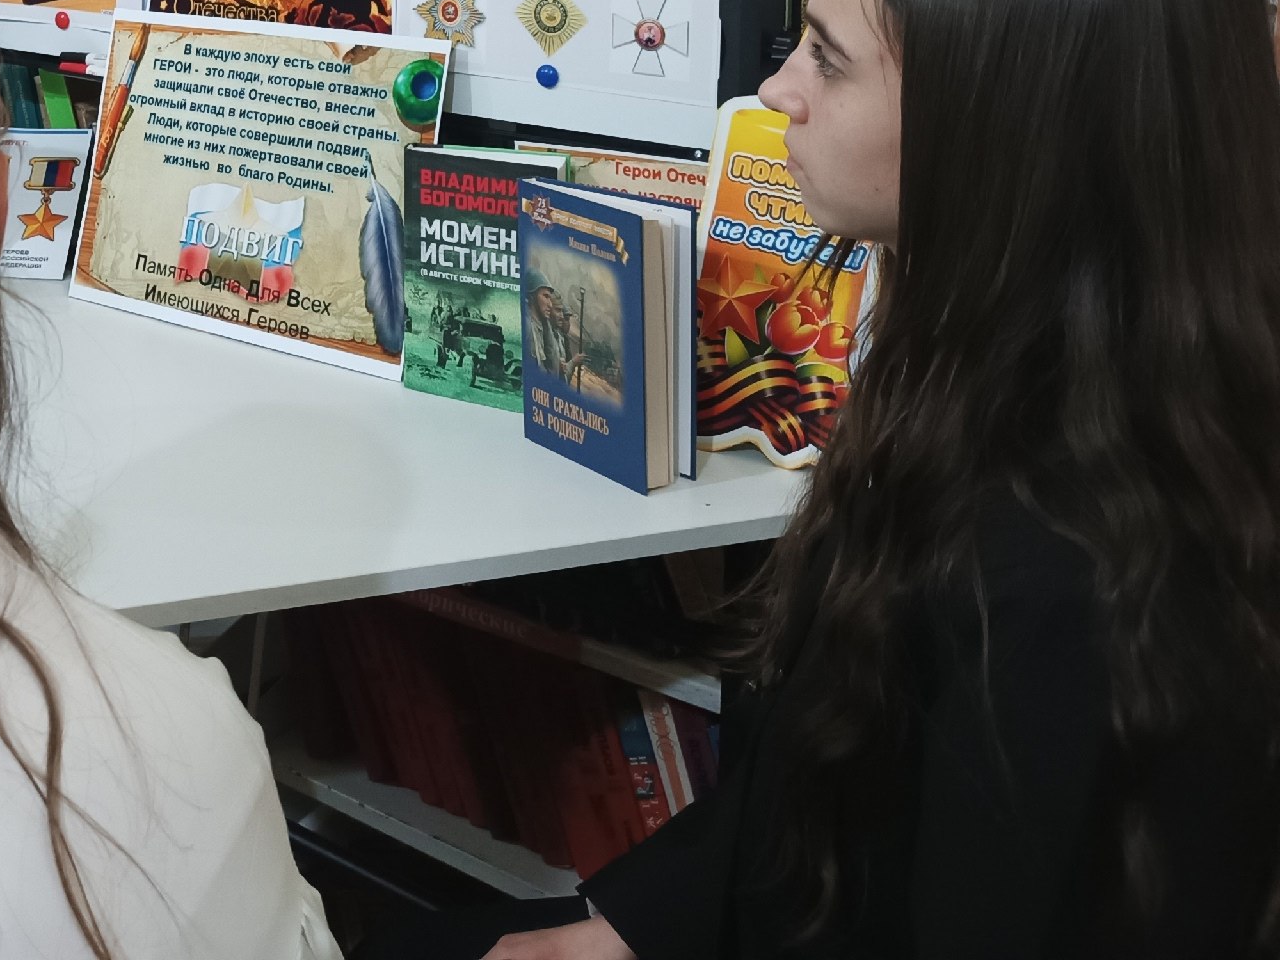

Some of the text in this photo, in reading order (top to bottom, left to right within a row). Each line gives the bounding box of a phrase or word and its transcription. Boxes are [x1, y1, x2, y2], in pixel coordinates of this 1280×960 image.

[183, 43, 352, 74] В каждую эпоху есть свои
[153, 59, 388, 100] ГЕРОИ это люди, которые отважно
[153, 78, 376, 118] защищали своё Отечество, внесли
[130, 93, 400, 142] огромный вклад в историю своей страны.
[143, 132, 368, 178] многие из них пожертвовали своей
[147, 113, 370, 162] Люди, которые совершили подвиг,
[162, 154, 334, 193] жизнью во благо Родины.
[420, 168, 518, 197] ВЛАДИМИ
[614, 160, 662, 182] Герои
[420, 188, 518, 218] БОГОМОЛО
[179, 216, 303, 266] ПОДВИГ
[420, 216, 517, 253] МОМЕН
[716, 220, 744, 239] не
[135, 253, 333, 317] Память Одна Для Всех
[429, 269, 482, 286] АВГУСТЕ СОРОК
[144, 283, 311, 340] Имеющихся Героев
[531, 386, 609, 436] ОНИ СРАЖАЛИСЬ
[532, 406, 586, 445] ЗА РОДИНУ
